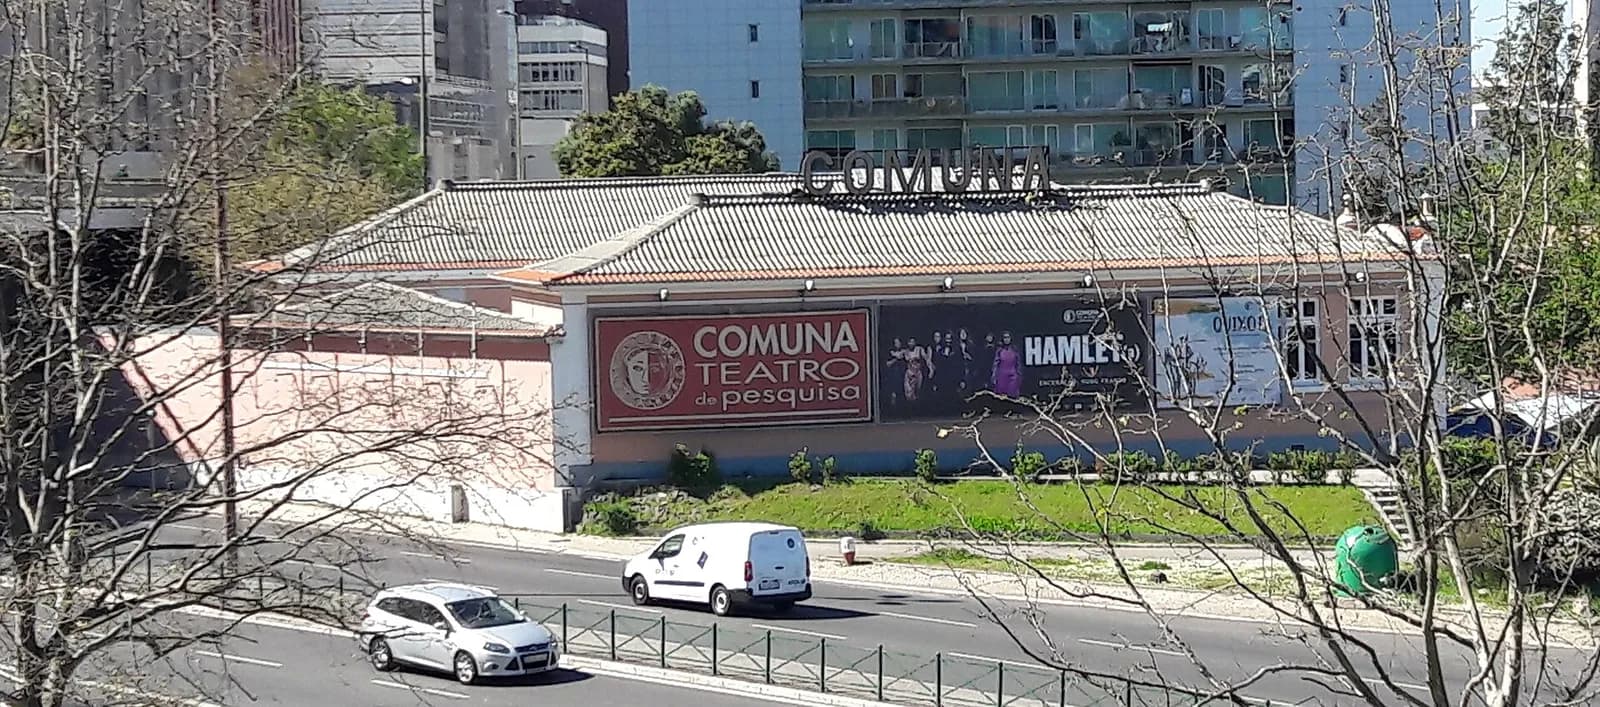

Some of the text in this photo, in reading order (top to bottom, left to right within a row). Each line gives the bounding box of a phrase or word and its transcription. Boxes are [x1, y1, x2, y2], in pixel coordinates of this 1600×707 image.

[803, 148, 1049, 195] COMUNA
[694, 321, 858, 358] COMUNA
[695, 358, 859, 385] TEATRO
[695, 383, 860, 411] de pesquisa
